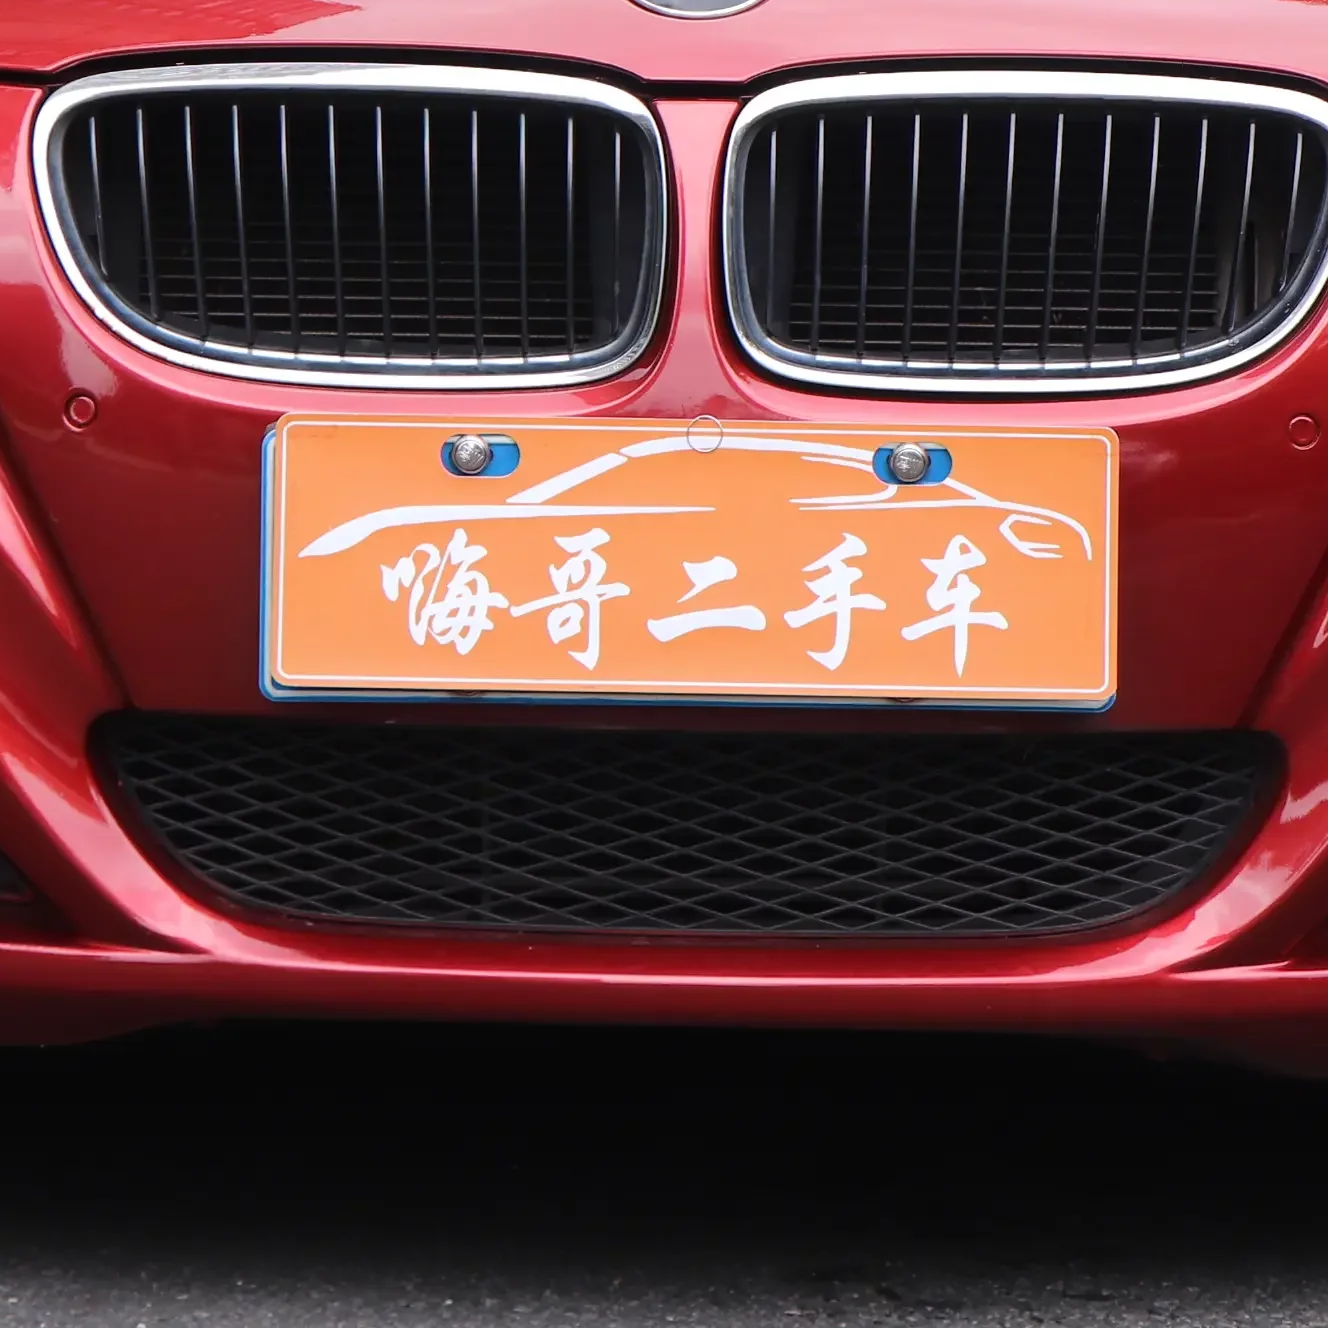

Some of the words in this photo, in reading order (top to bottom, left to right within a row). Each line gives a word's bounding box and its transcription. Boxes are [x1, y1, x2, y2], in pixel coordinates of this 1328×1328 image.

[380, 527, 1009, 677] 嗨哥二手车
